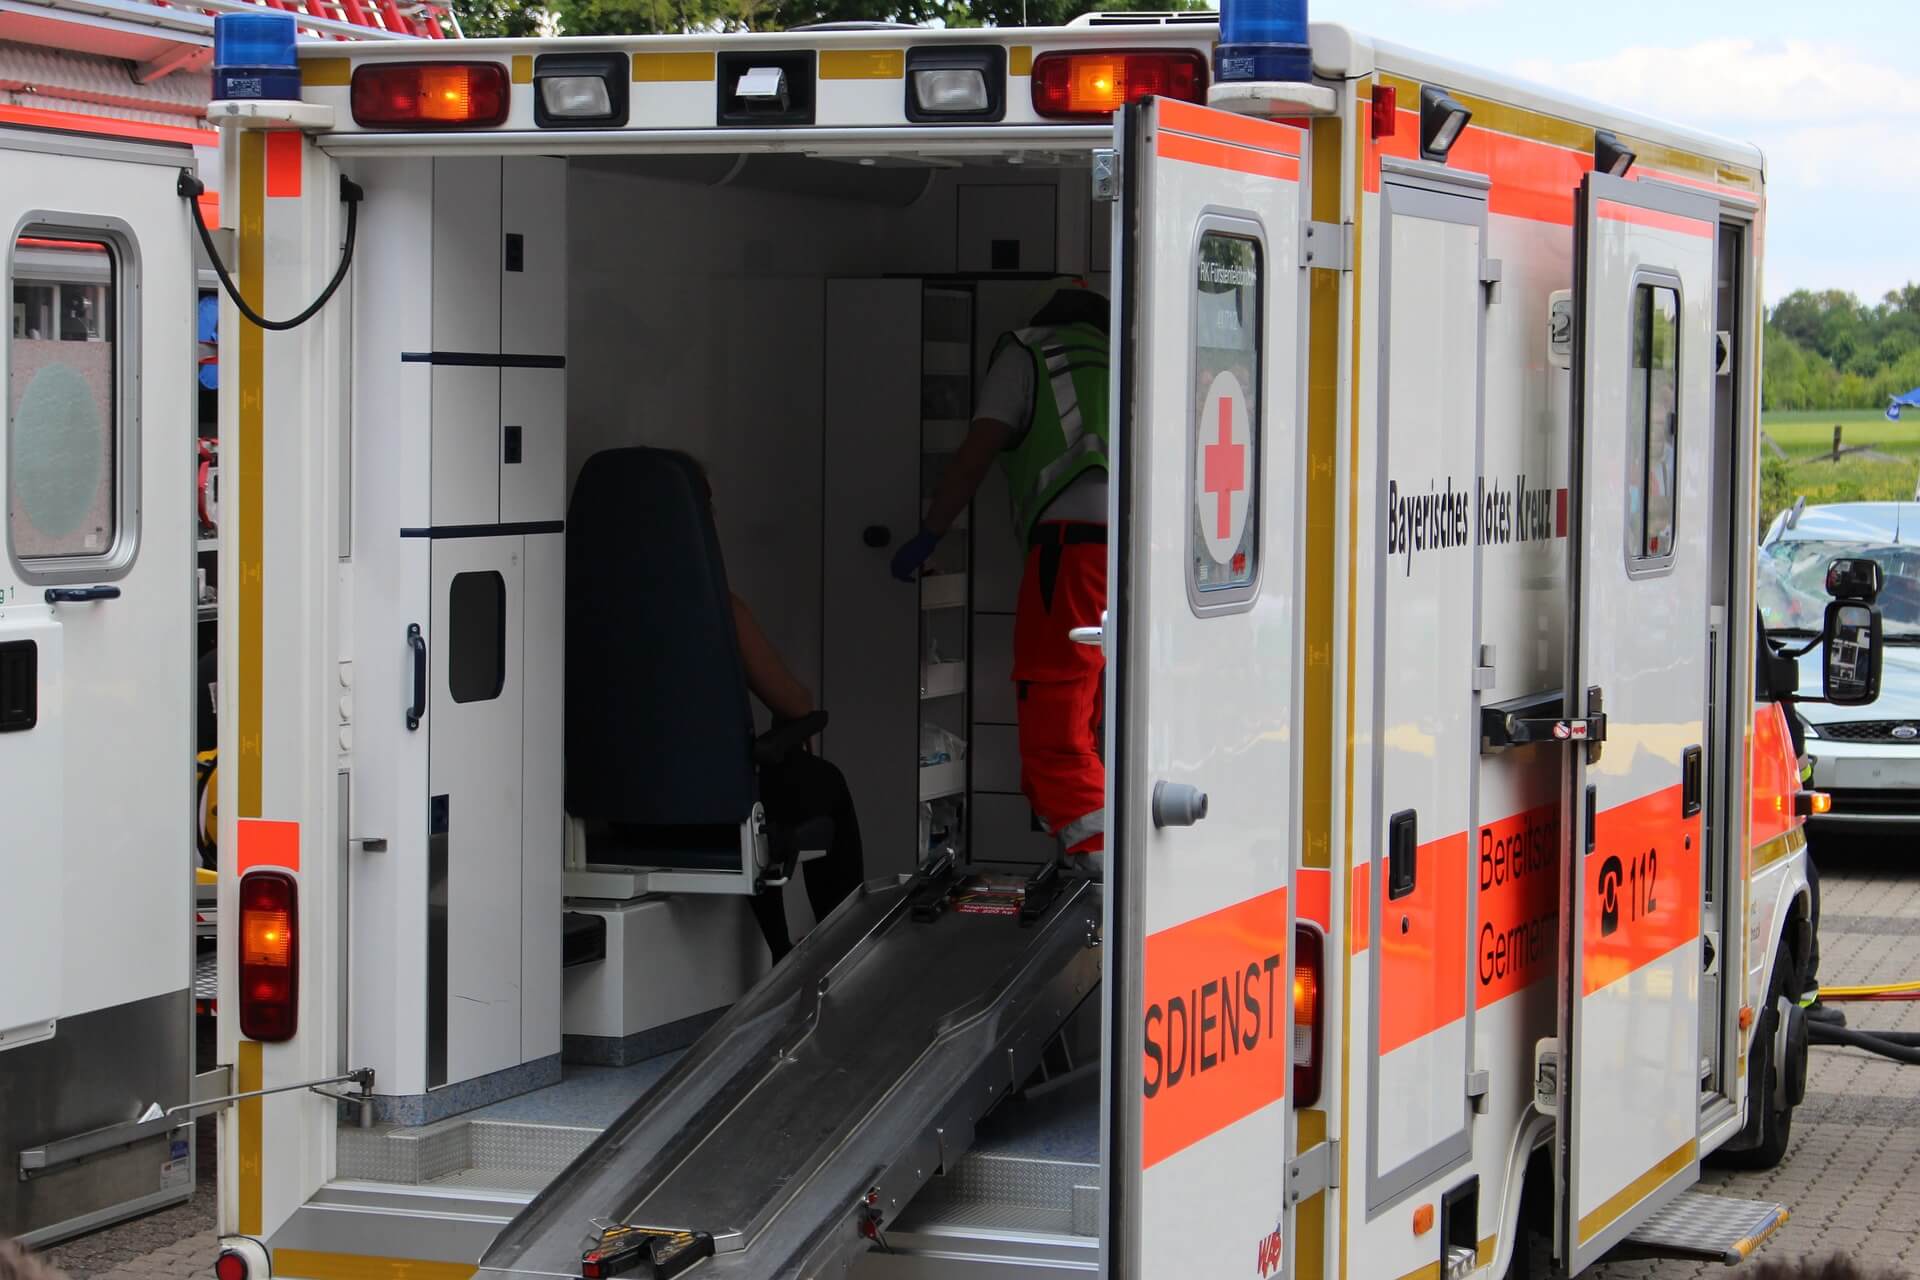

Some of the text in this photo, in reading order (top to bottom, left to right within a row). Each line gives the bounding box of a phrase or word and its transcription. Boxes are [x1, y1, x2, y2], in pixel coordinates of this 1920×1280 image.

[1388, 476, 1468, 577] Bayerisches
[1516, 474, 1551, 542] Kreuz
[1630, 848, 1657, 922] 112
[1143, 953, 1280, 1099] SDIENST
